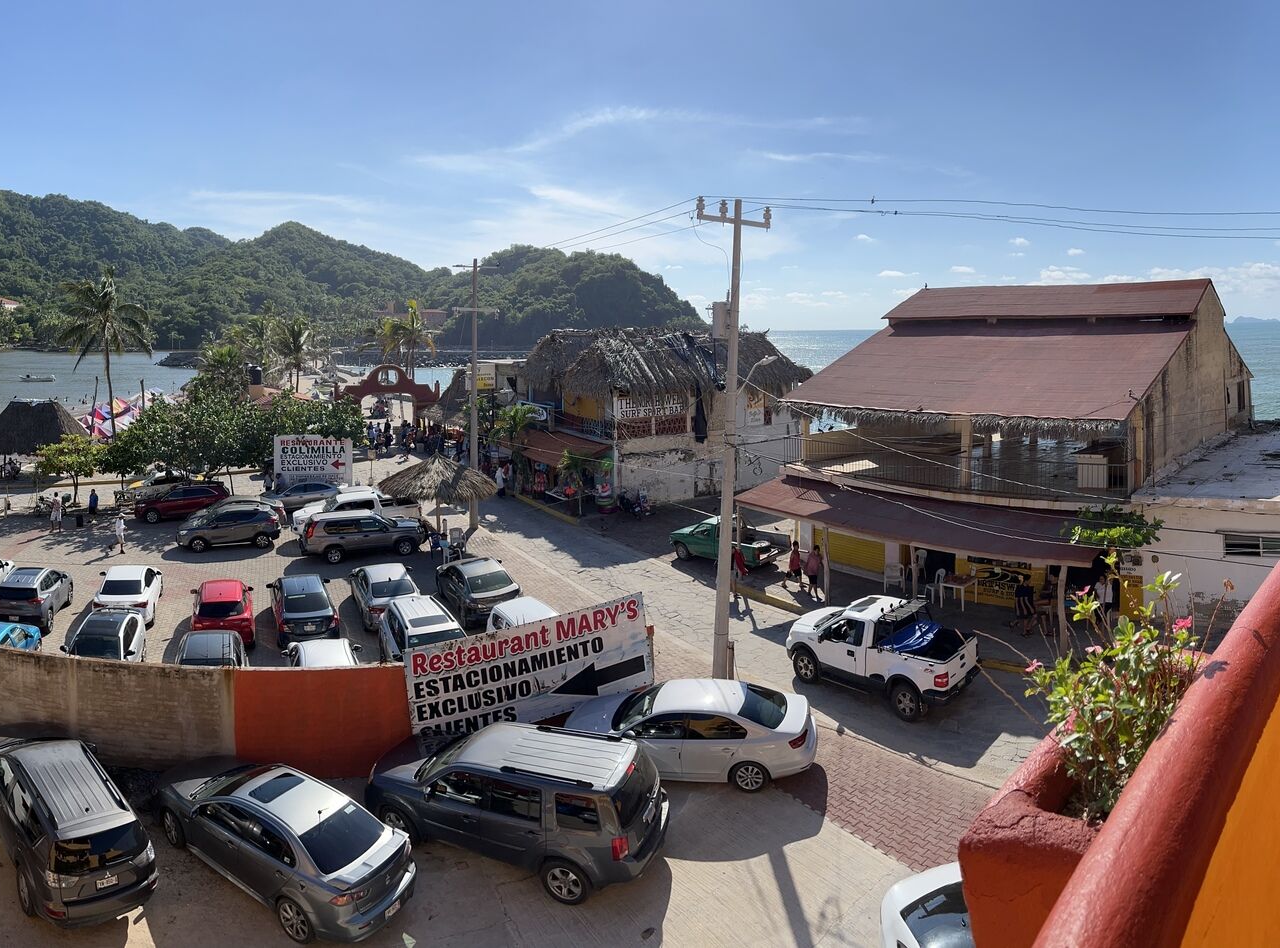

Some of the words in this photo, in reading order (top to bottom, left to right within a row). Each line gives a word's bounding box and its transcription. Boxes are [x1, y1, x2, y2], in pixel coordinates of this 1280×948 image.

[620, 409, 641, 418] SURF
[643, 407, 669, 416] SPRT
[669, 405, 685, 414] BAR
[282, 446, 345, 454] COLIMILLA
[411, 625, 550, 677] Restaurant
[555, 599, 641, 643] MARY'S
[413, 636, 604, 700] ESTACIONAMIENTO
[416, 680, 533, 723] EXCLUSIVO
[420, 706, 518, 738] CLIENTES
